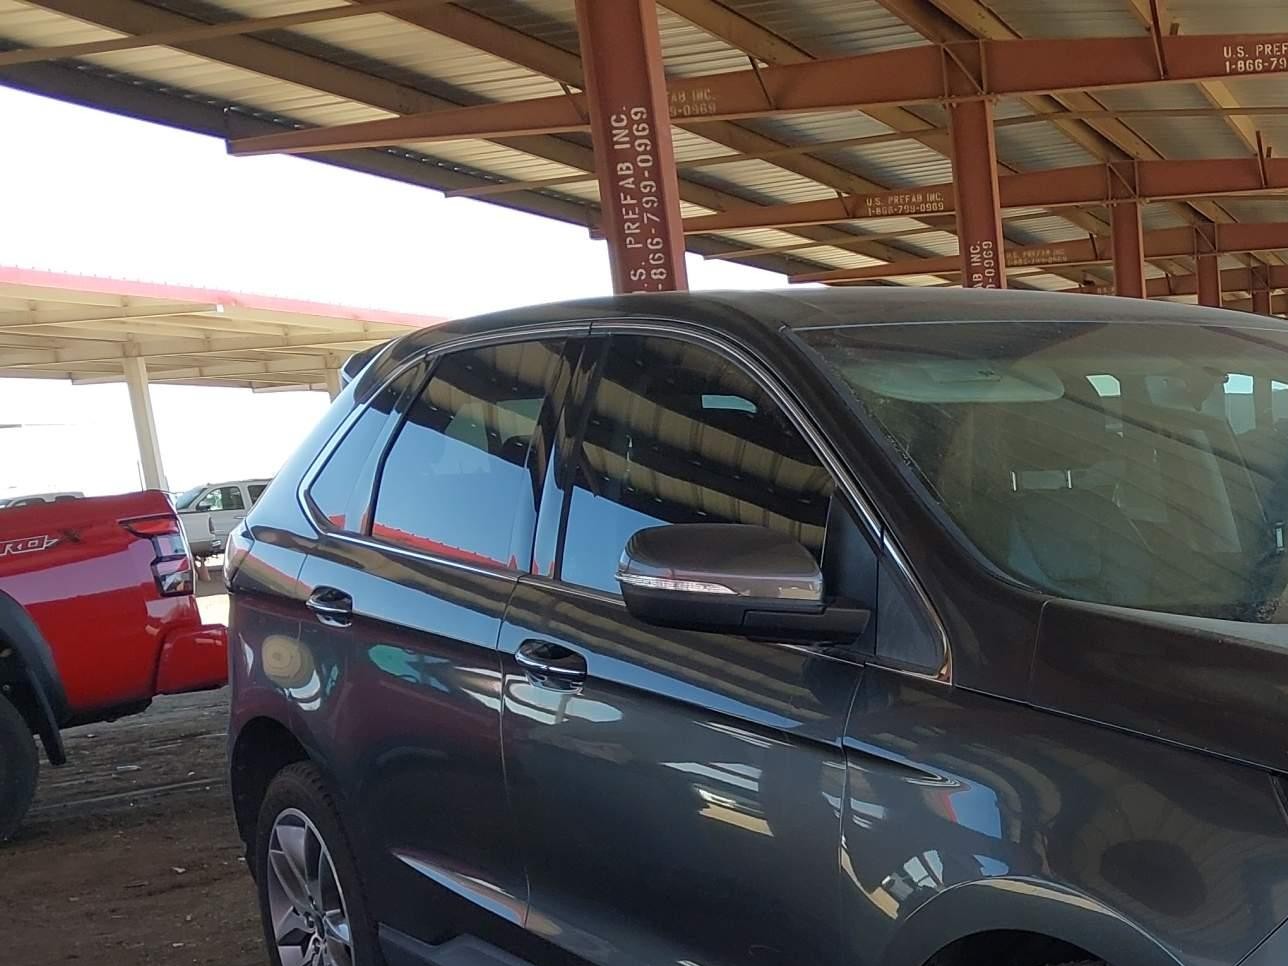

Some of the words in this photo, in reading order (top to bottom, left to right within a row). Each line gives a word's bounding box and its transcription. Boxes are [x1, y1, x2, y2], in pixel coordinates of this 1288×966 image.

[1223, 45, 1249, 58] U.S.
[610, 105, 631, 150] INC.
[616, 161, 643, 249] PREFAB
[969, 240, 982, 266] INC.
[630, 261, 648, 294] .S.
